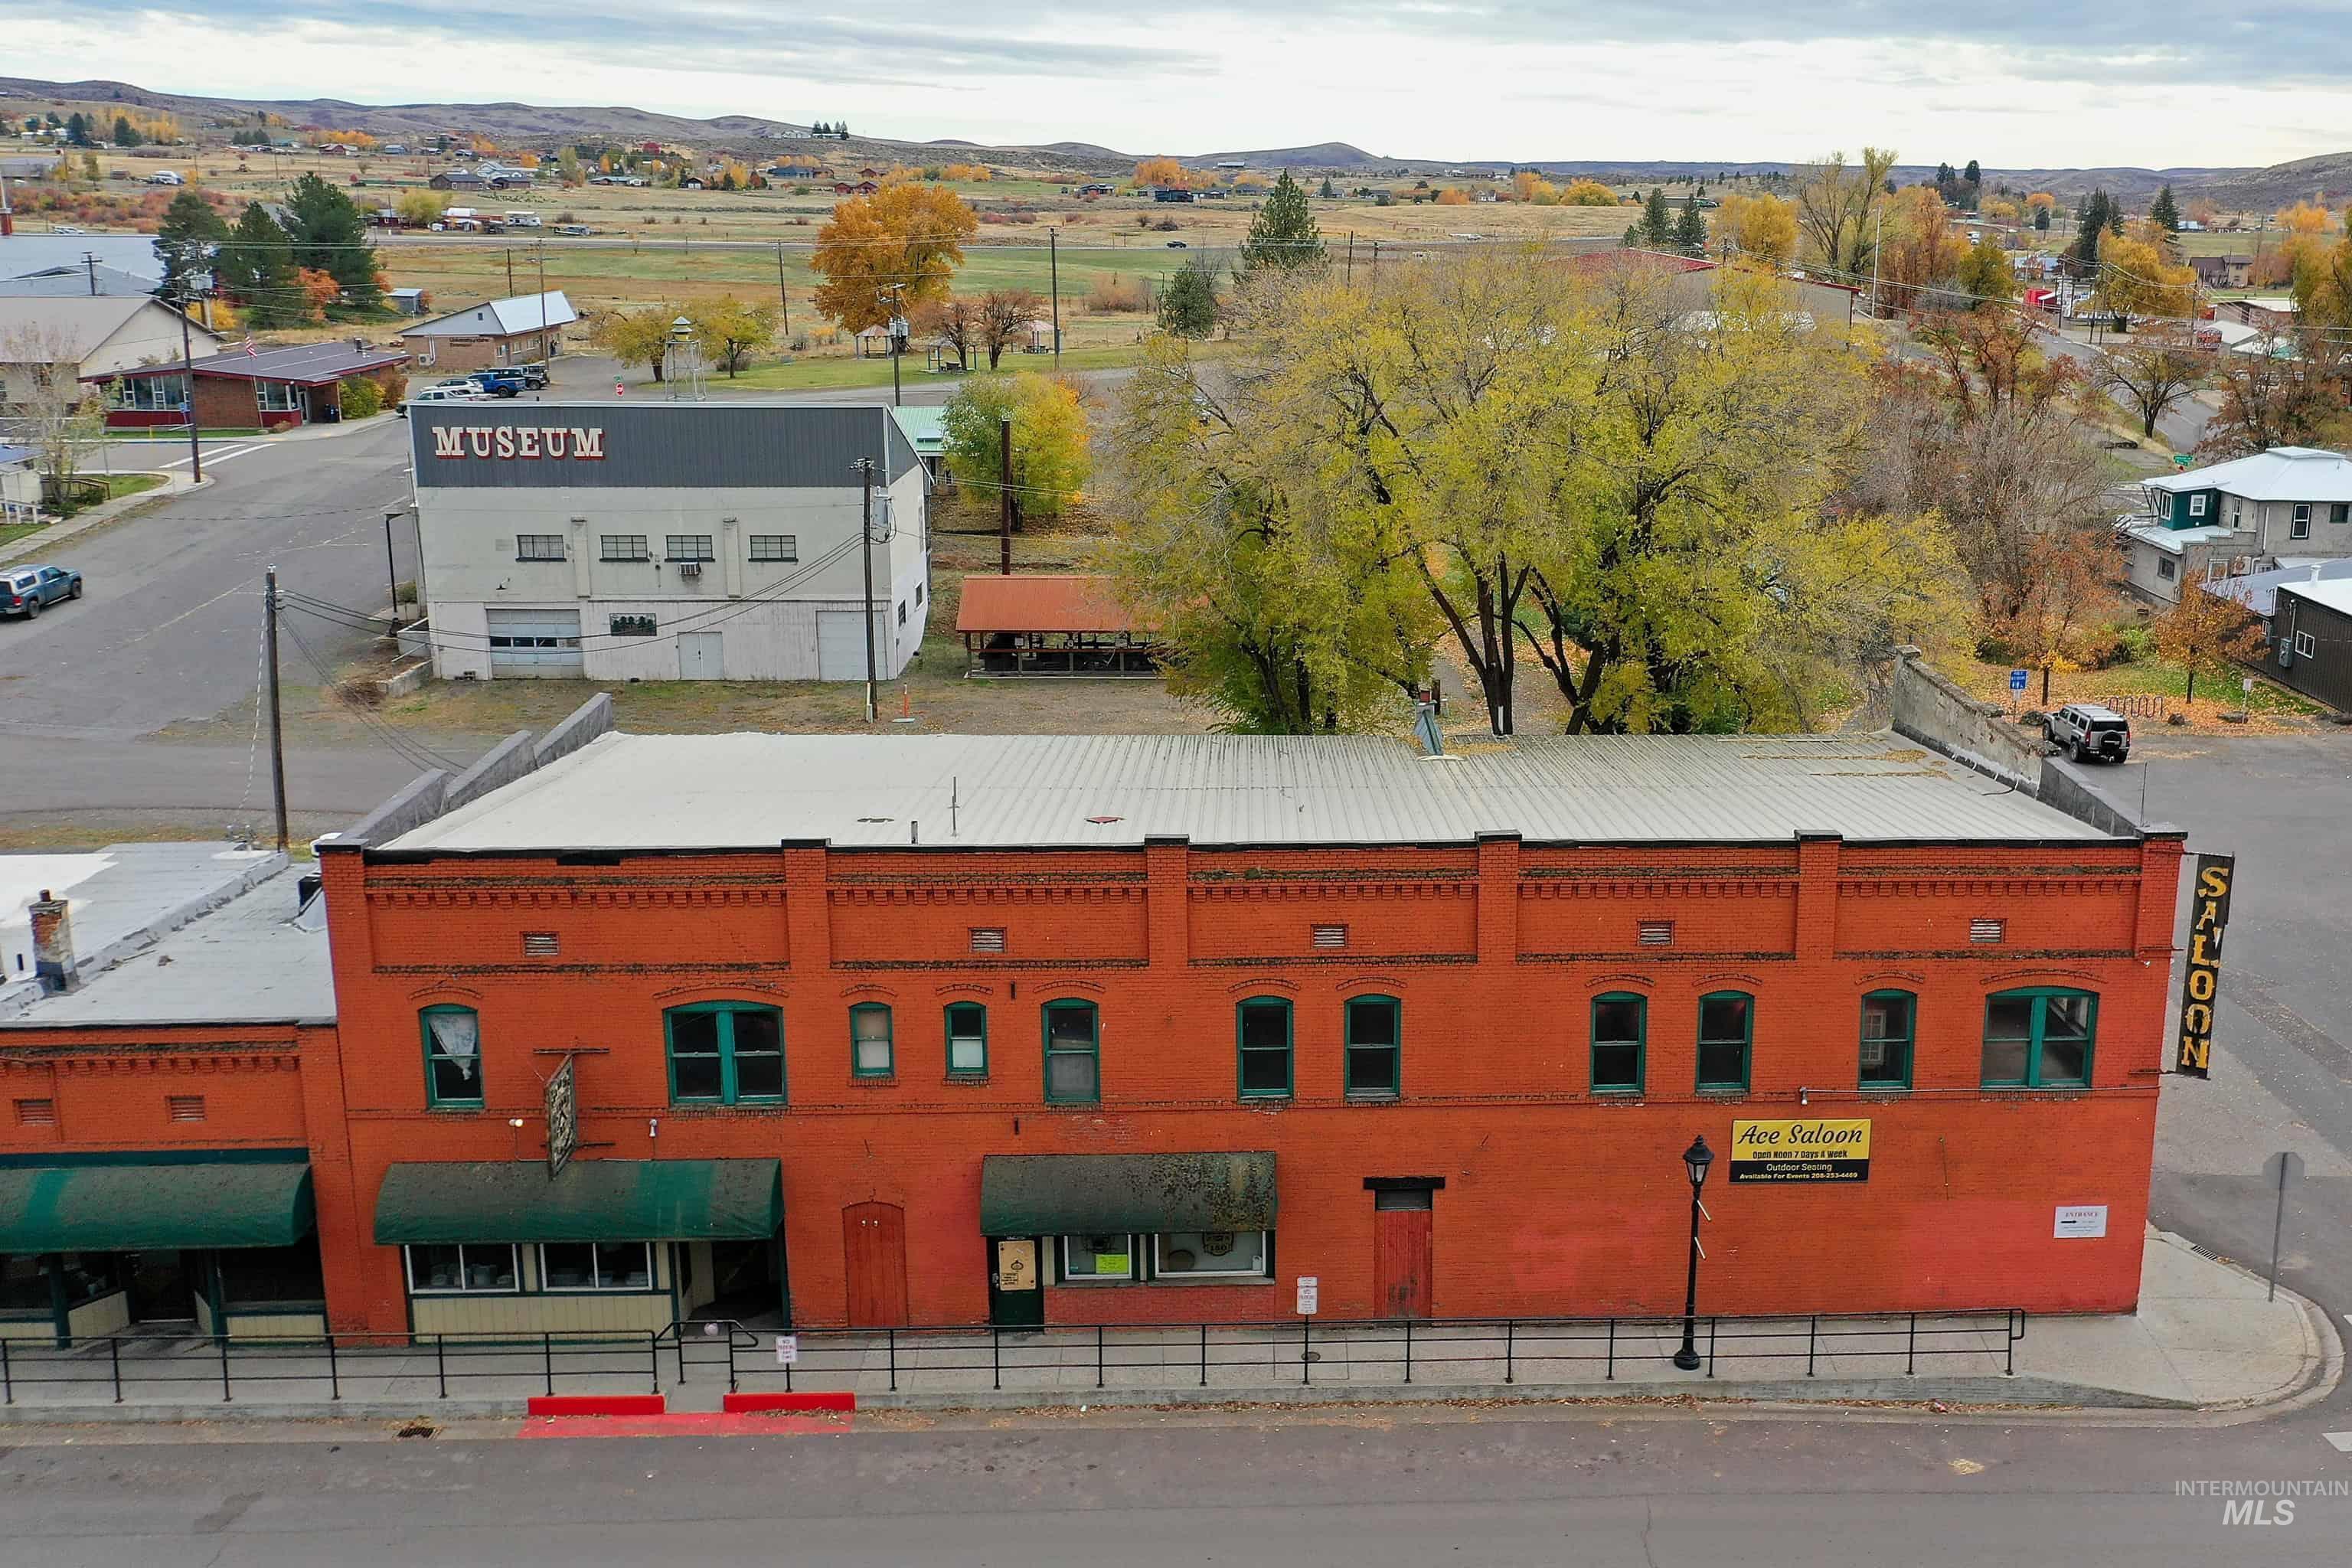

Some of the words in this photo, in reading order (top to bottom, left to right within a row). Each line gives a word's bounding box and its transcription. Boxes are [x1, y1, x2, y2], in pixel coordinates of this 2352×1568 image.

[432, 426, 606, 459] MUSEUM
[2181, 866, 2230, 1070] SALOON
[1738, 1125, 1780, 1144] Ace
[1788, 1123, 1862, 1144] Saloon
[1766, 1163, 1799, 1171] Outdoor
[1802, 1163, 1832, 1172] Seating
